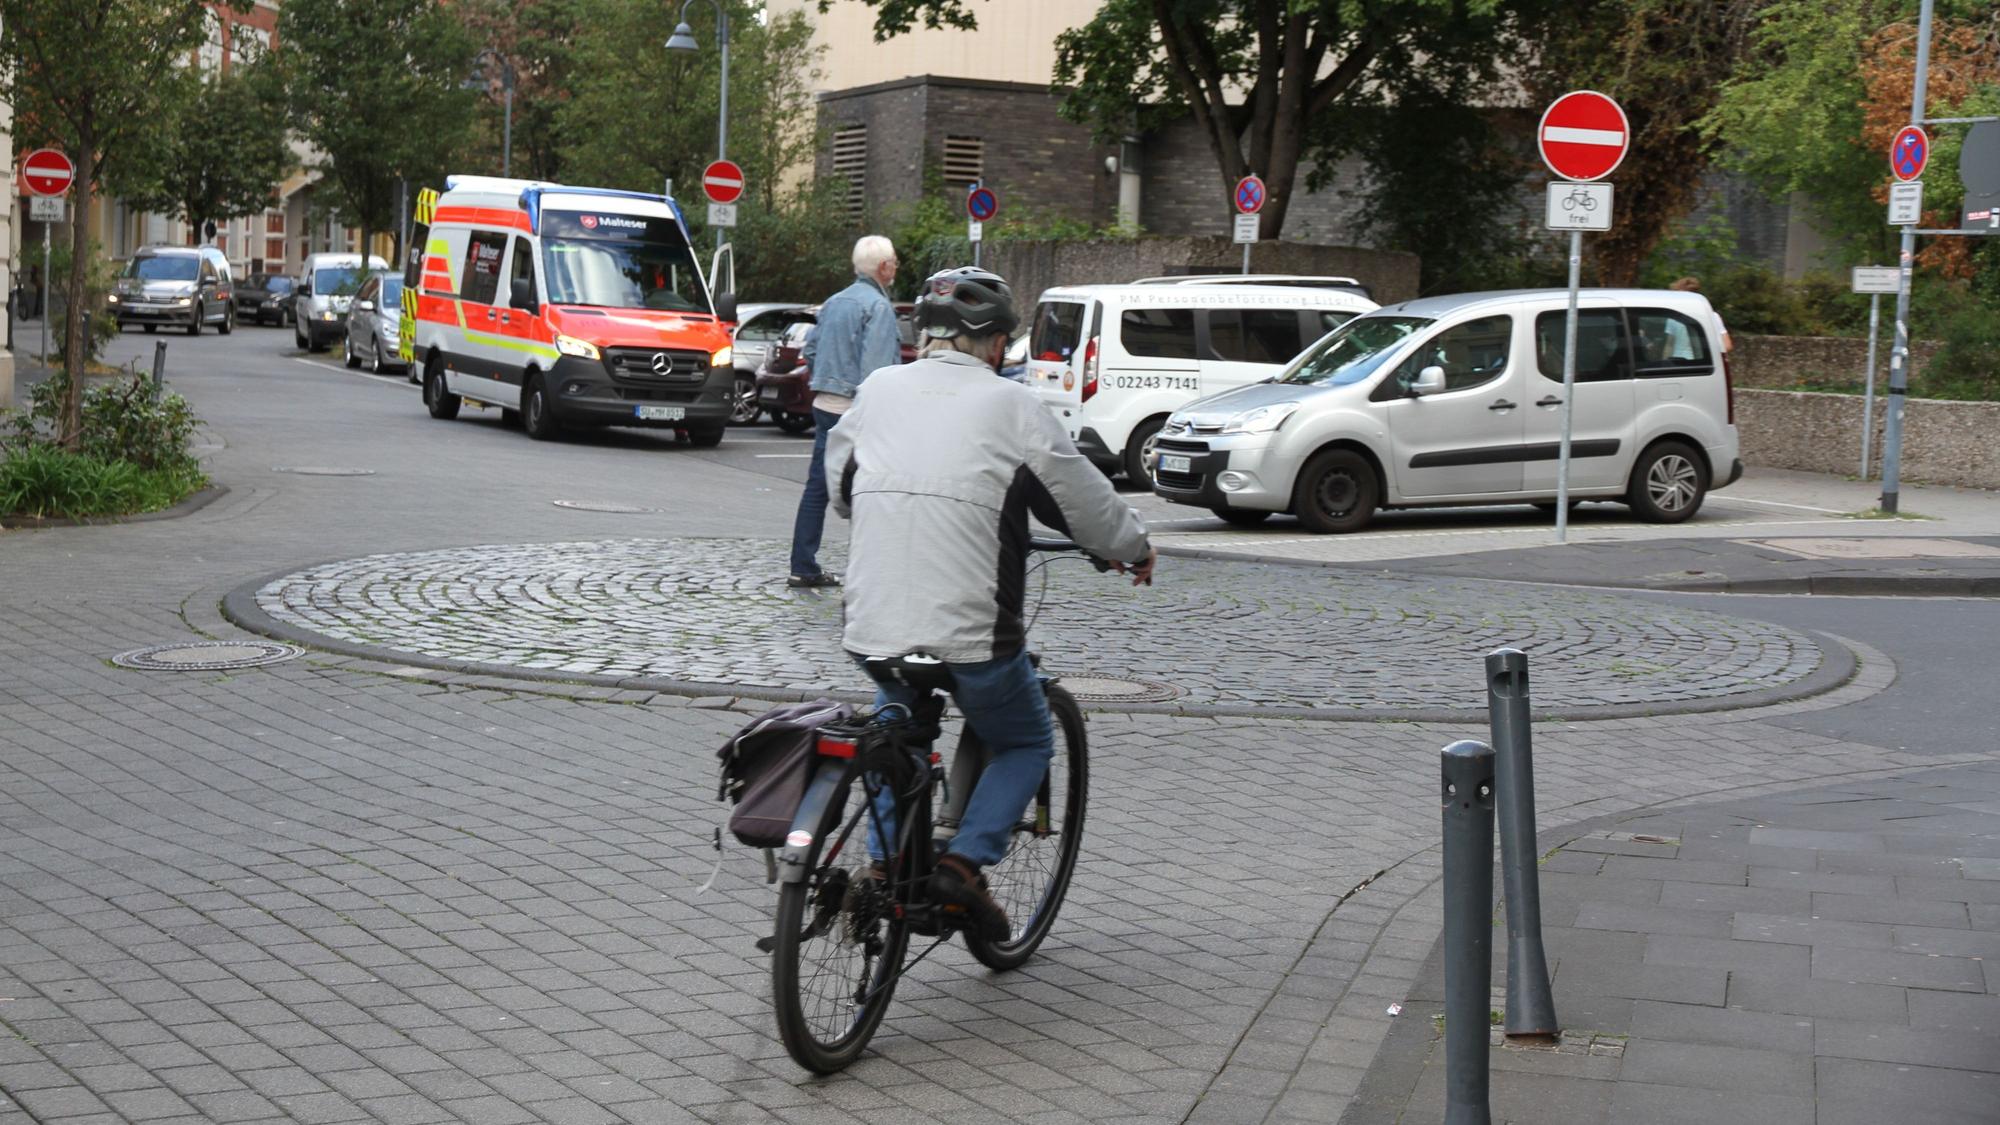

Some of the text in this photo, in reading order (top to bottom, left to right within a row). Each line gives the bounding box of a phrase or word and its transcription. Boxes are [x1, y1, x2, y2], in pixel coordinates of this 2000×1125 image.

[598, 216, 648, 229] Malteser
[1569, 213, 1589, 224] frei
[1116, 376, 1198, 390] 02243 7141
